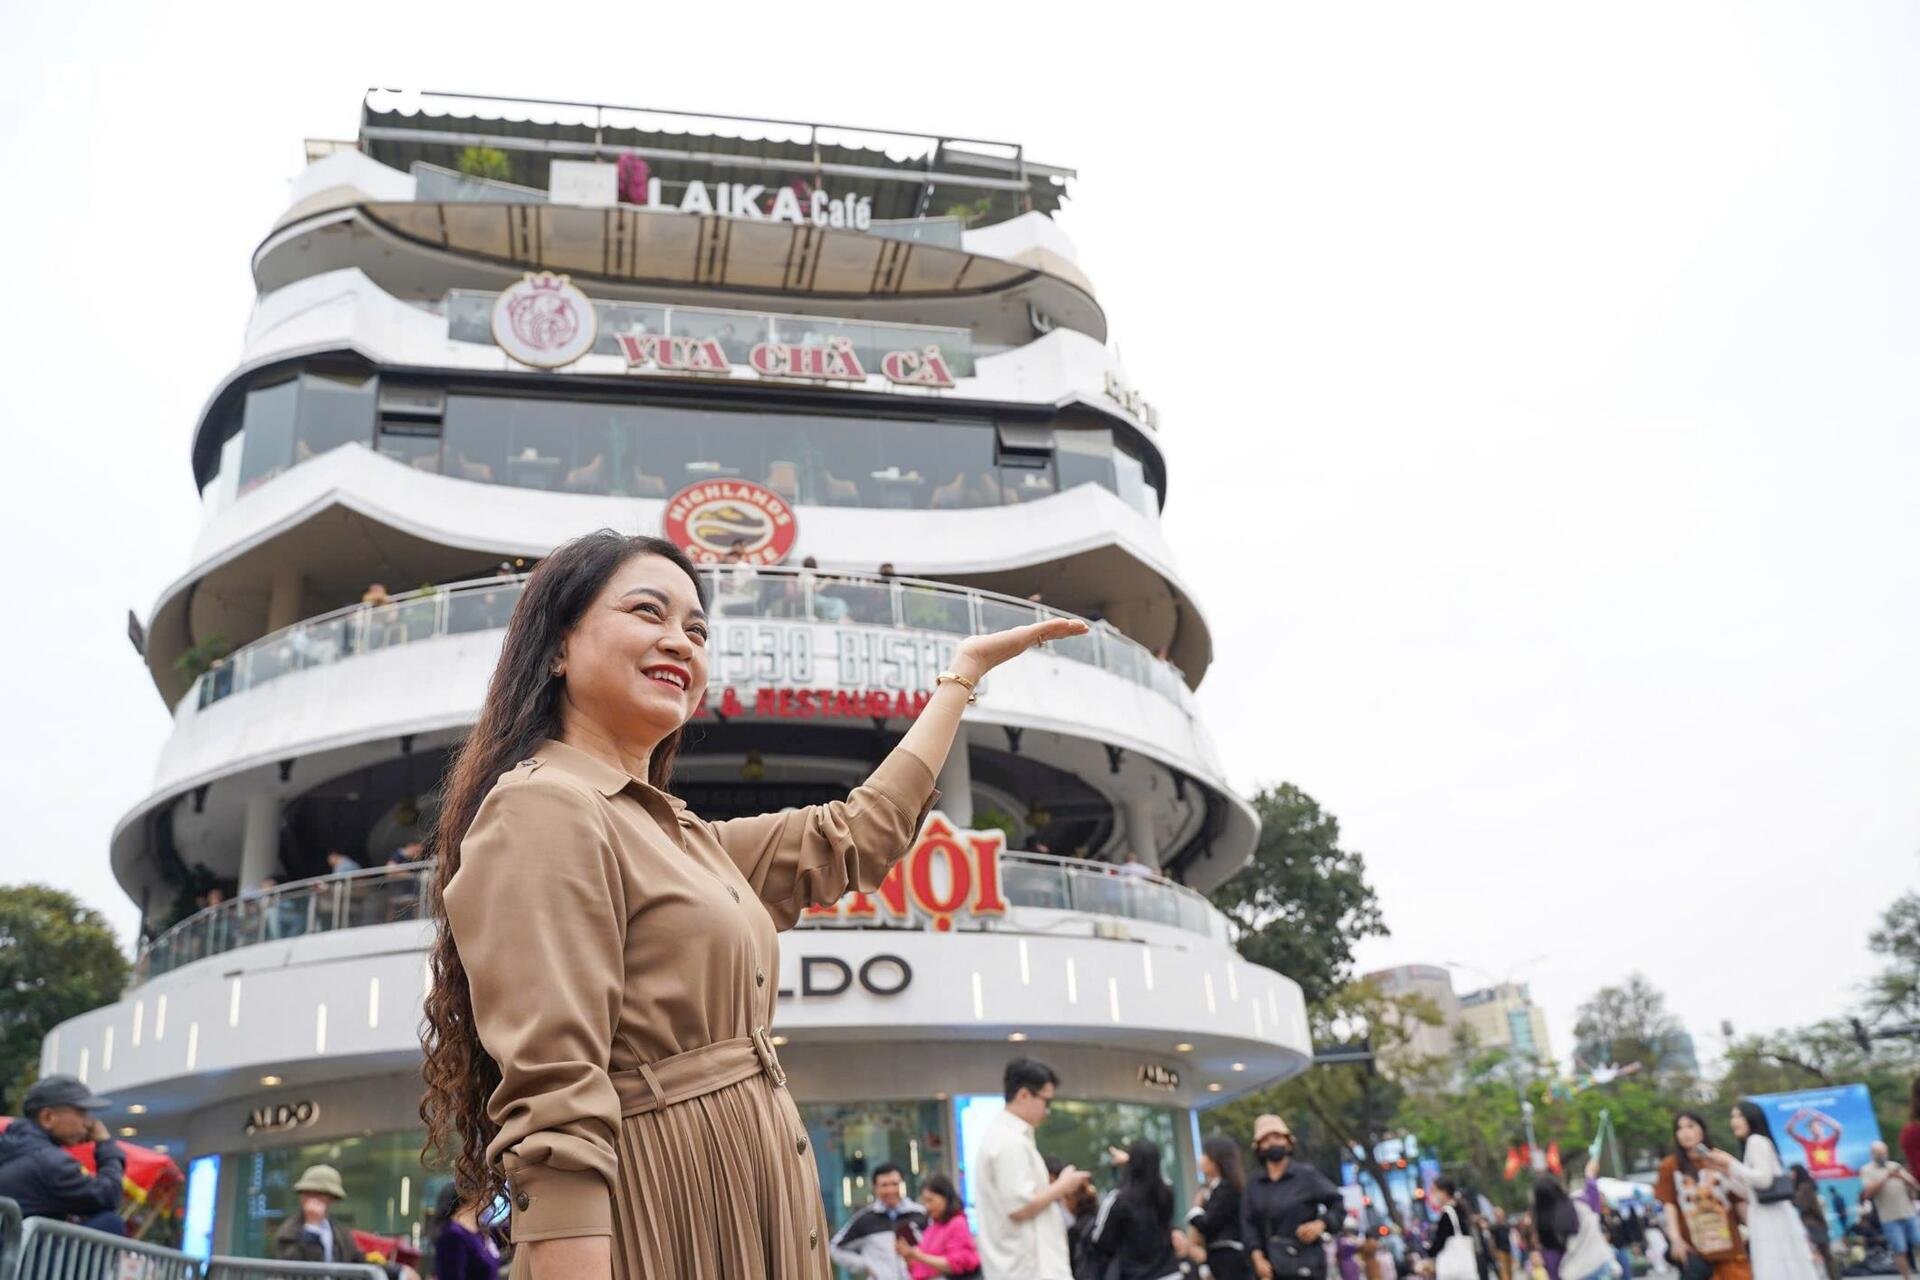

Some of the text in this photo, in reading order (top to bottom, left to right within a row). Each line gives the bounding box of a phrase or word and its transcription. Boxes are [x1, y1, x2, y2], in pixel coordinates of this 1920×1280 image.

[647, 176, 872, 232] LAIKA Café
[615, 332, 731, 374] VUA
[669, 483, 791, 526] HIGHLANDS
[685, 544, 779, 566] COEE
[836, 629, 964, 694] BISTR
[721, 686, 744, 717] &
[755, 687, 934, 720] RESTAURAN
[777, 954, 913, 997] DO
[244, 1101, 319, 1135] ALDO
